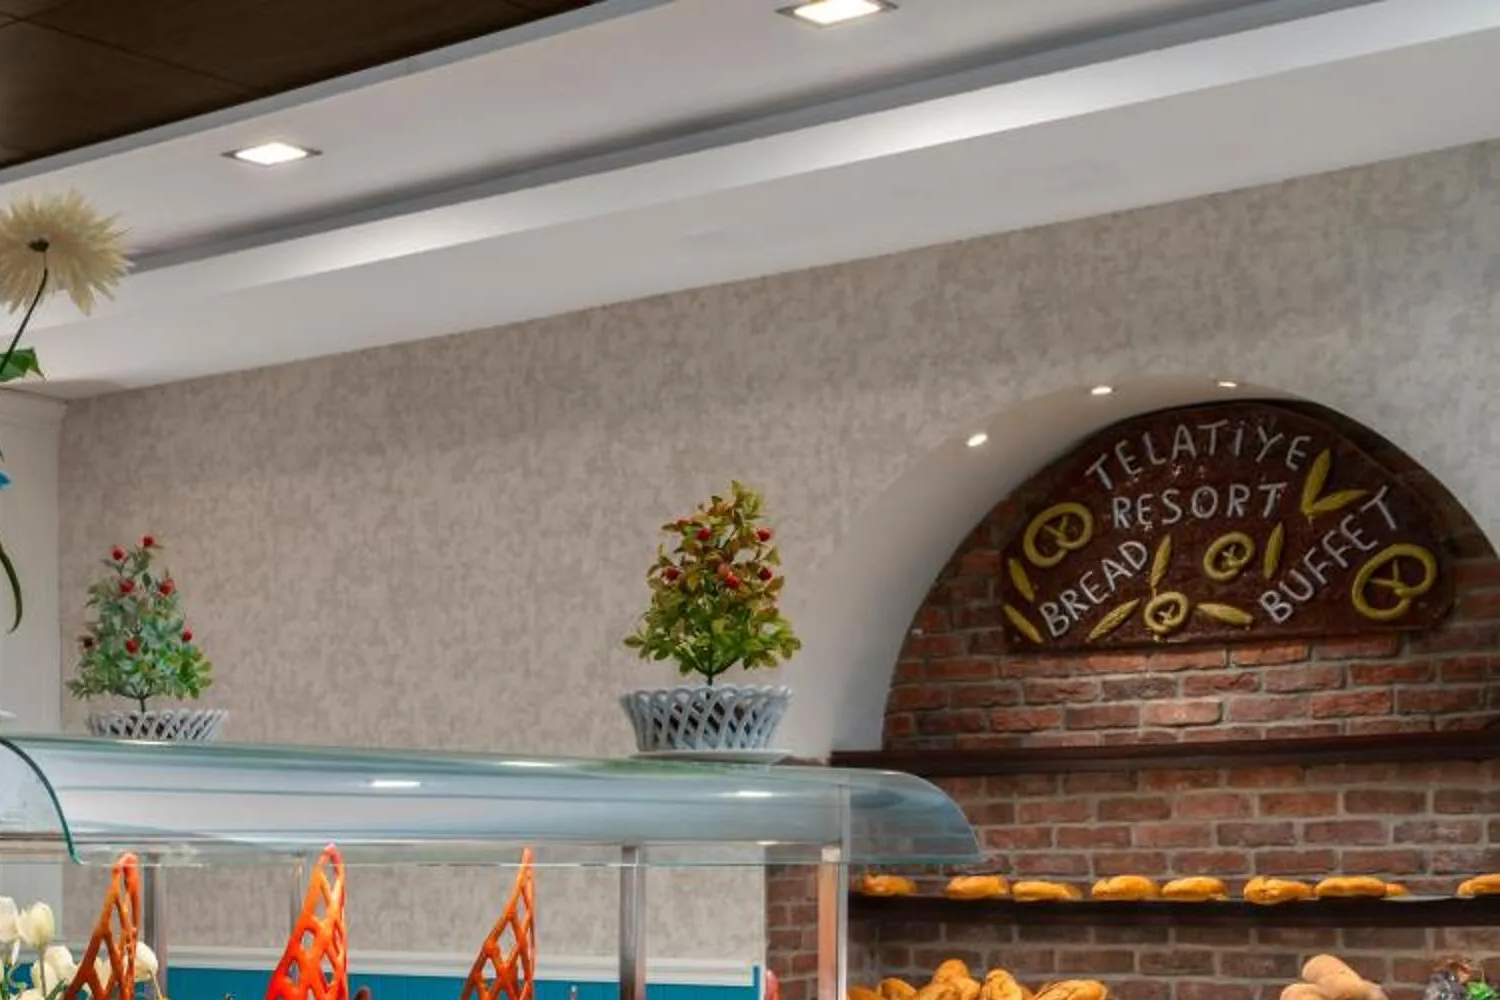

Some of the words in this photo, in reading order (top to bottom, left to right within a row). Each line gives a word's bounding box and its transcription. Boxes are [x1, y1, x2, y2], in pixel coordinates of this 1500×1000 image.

[1113, 482, 1288, 530] RESORT
[1260, 486, 1398, 623] BUFFET
[1039, 540, 1149, 638] BREAD
